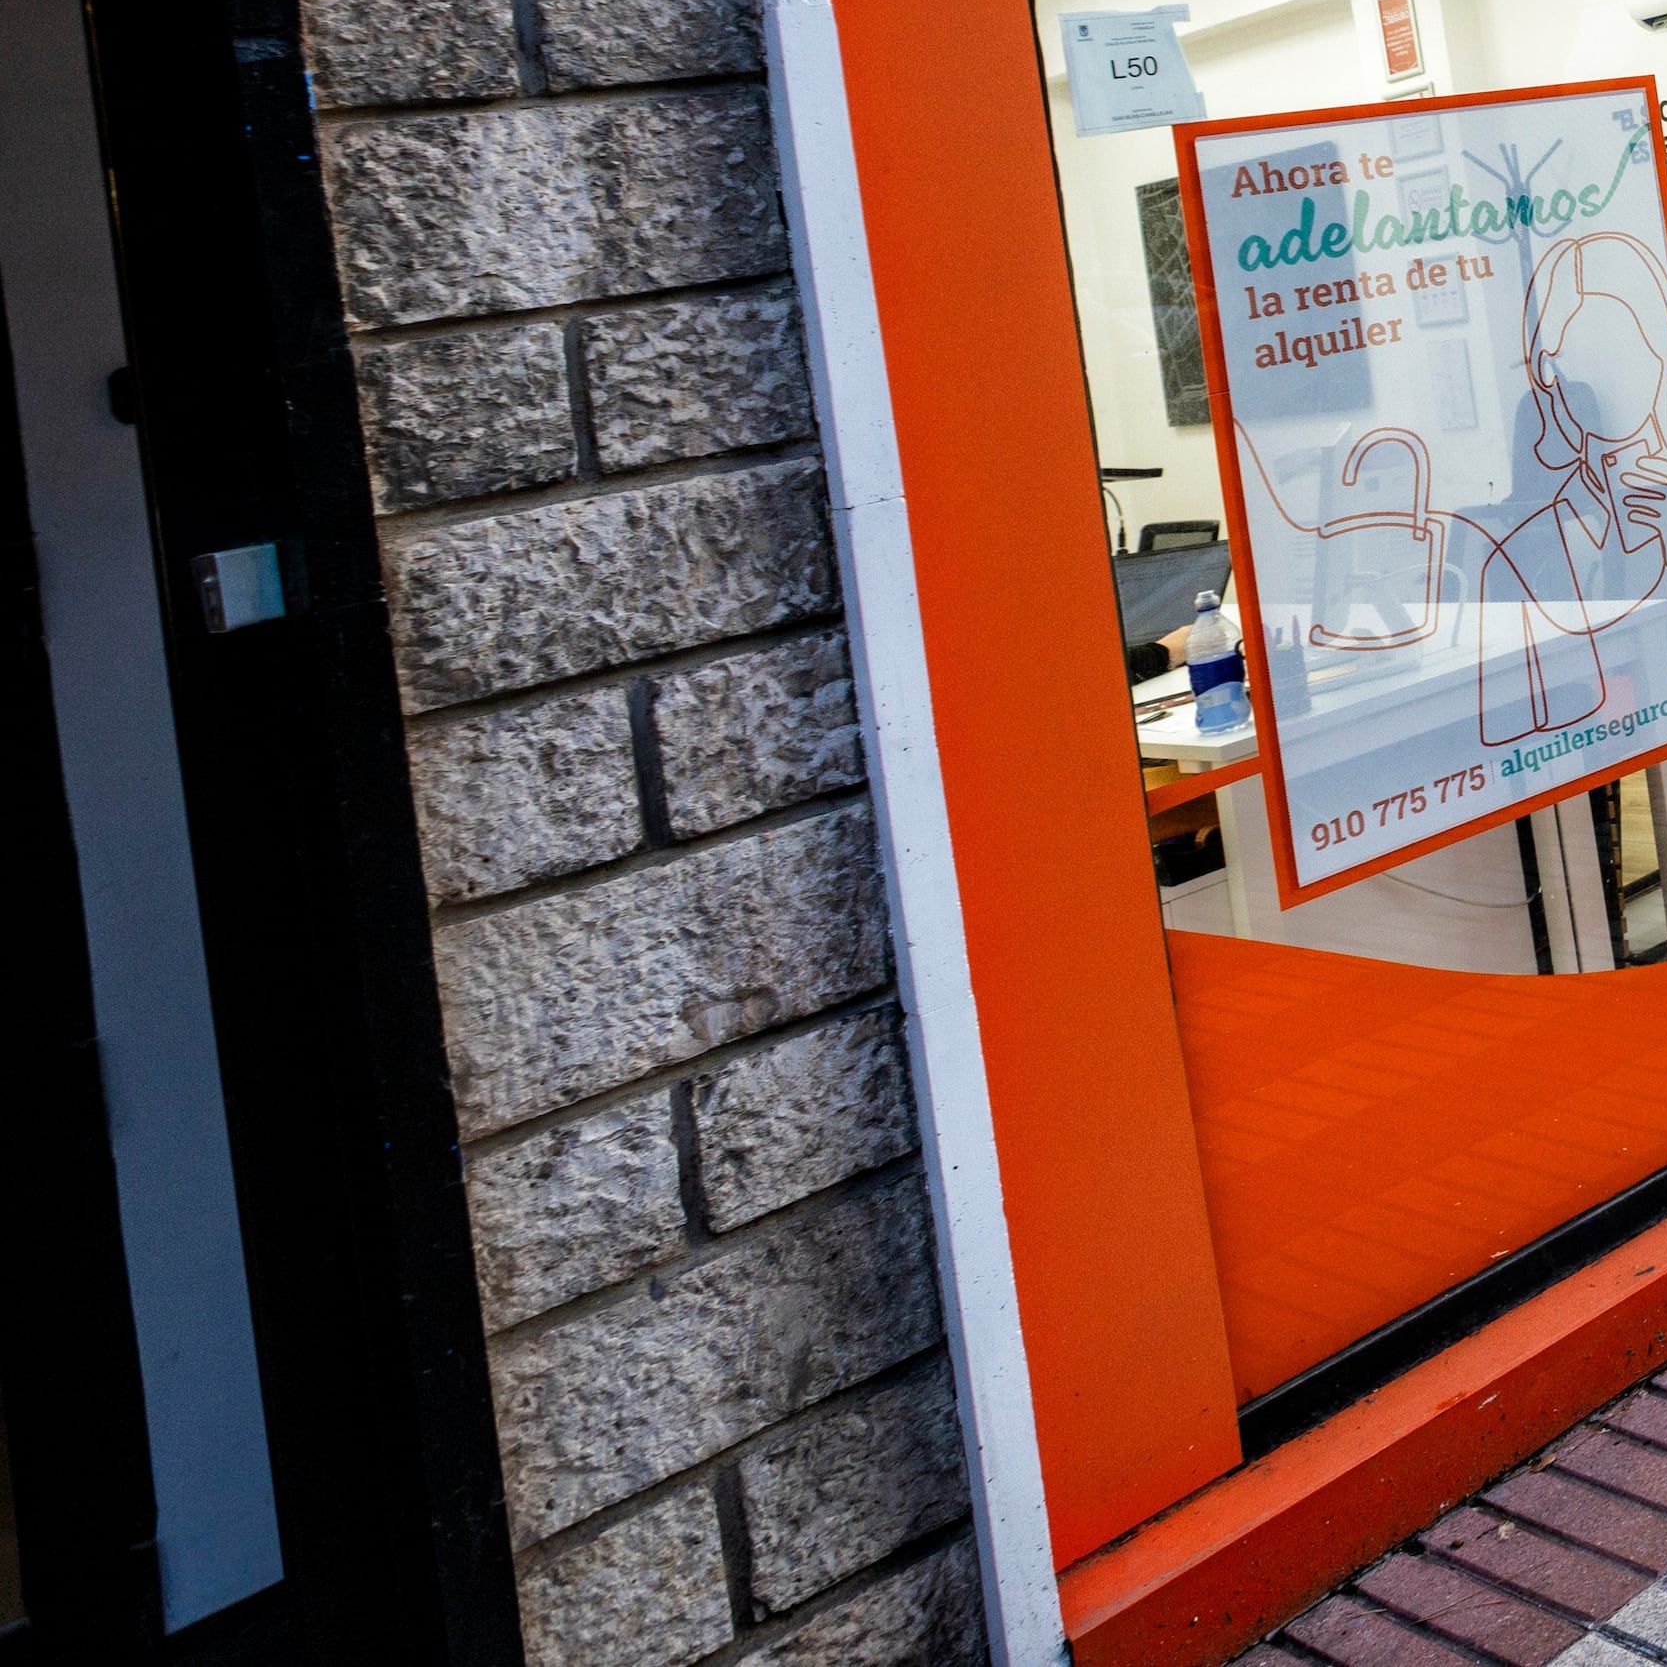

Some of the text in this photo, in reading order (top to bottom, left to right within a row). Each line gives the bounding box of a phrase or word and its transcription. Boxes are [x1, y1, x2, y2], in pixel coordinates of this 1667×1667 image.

[1110, 55, 1158, 80] L50
[1230, 152, 1396, 198] Ahora te
[1237, 162, 1620, 272] adelantamos
[1244, 254, 1495, 320] la renta de tu
[1254, 315, 1403, 370] alquiler
[1311, 809, 1365, 852] 910
[1372, 785, 1428, 829] 775
[1433, 763, 1487, 805] 775
